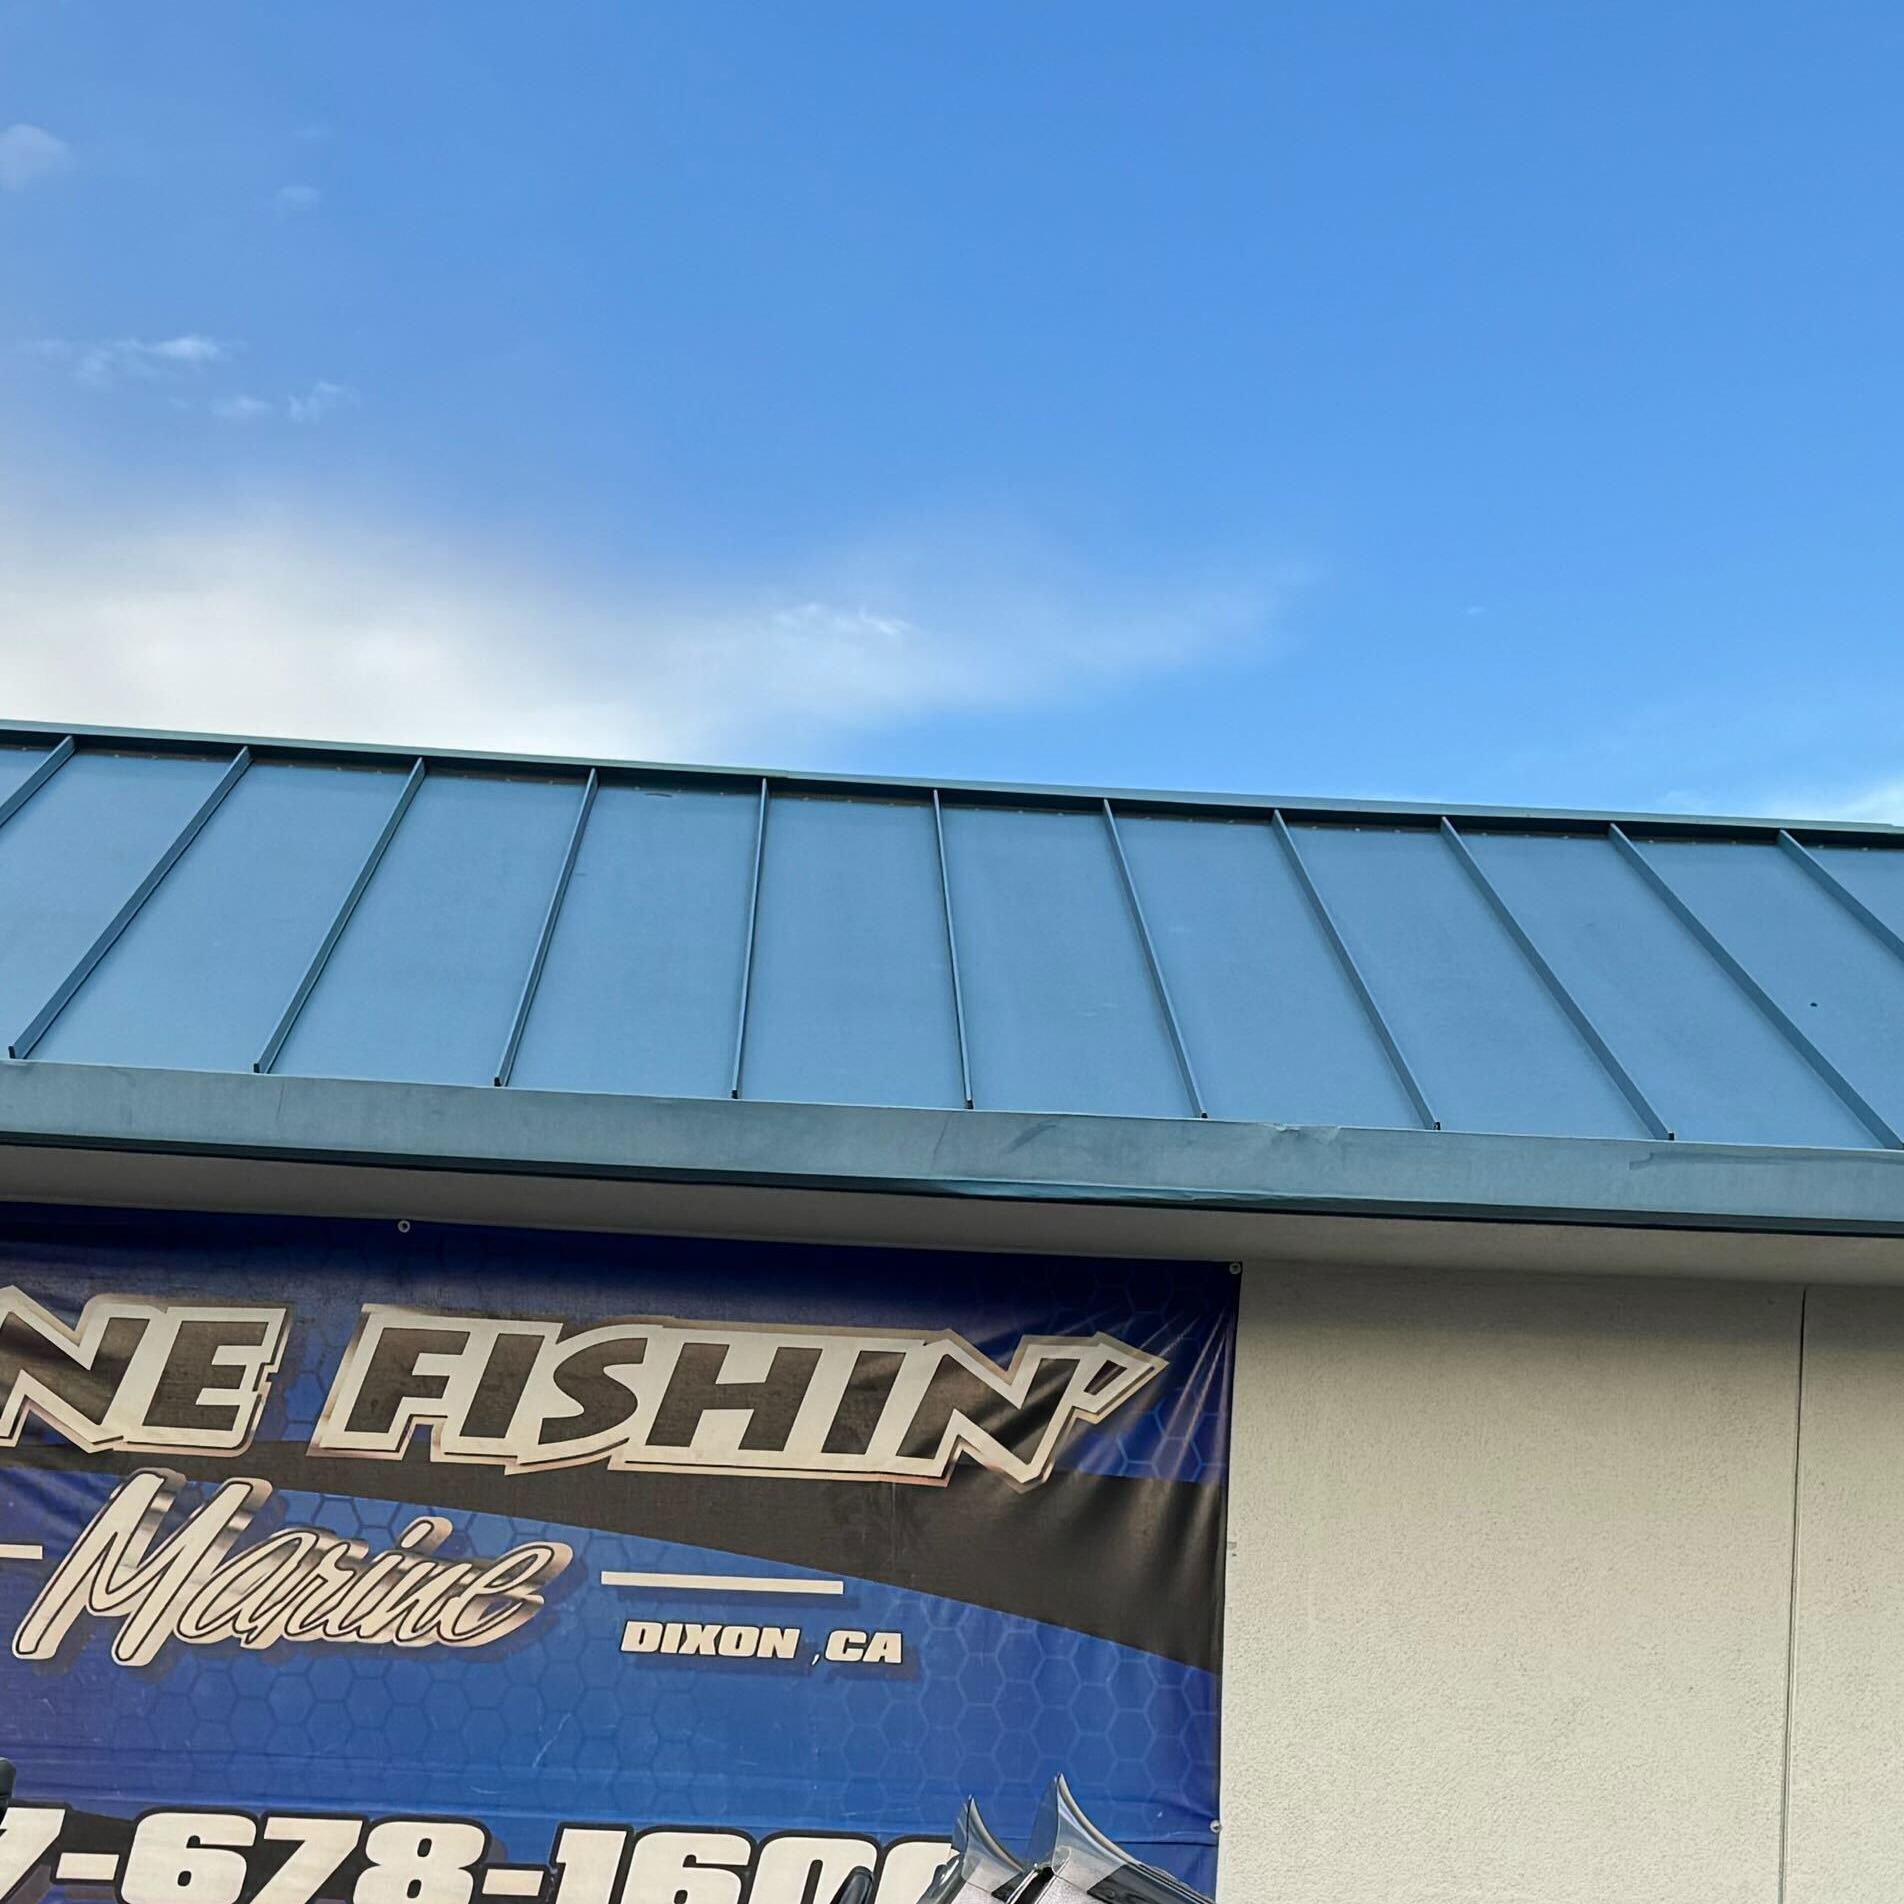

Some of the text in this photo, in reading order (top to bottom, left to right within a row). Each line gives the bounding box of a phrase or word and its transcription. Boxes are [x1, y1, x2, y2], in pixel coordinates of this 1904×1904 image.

[316, 1306, 1167, 1486] FISHIN'
[12, 1468, 573, 1667] Marine
[620, 1620, 801, 1660] DIXON
